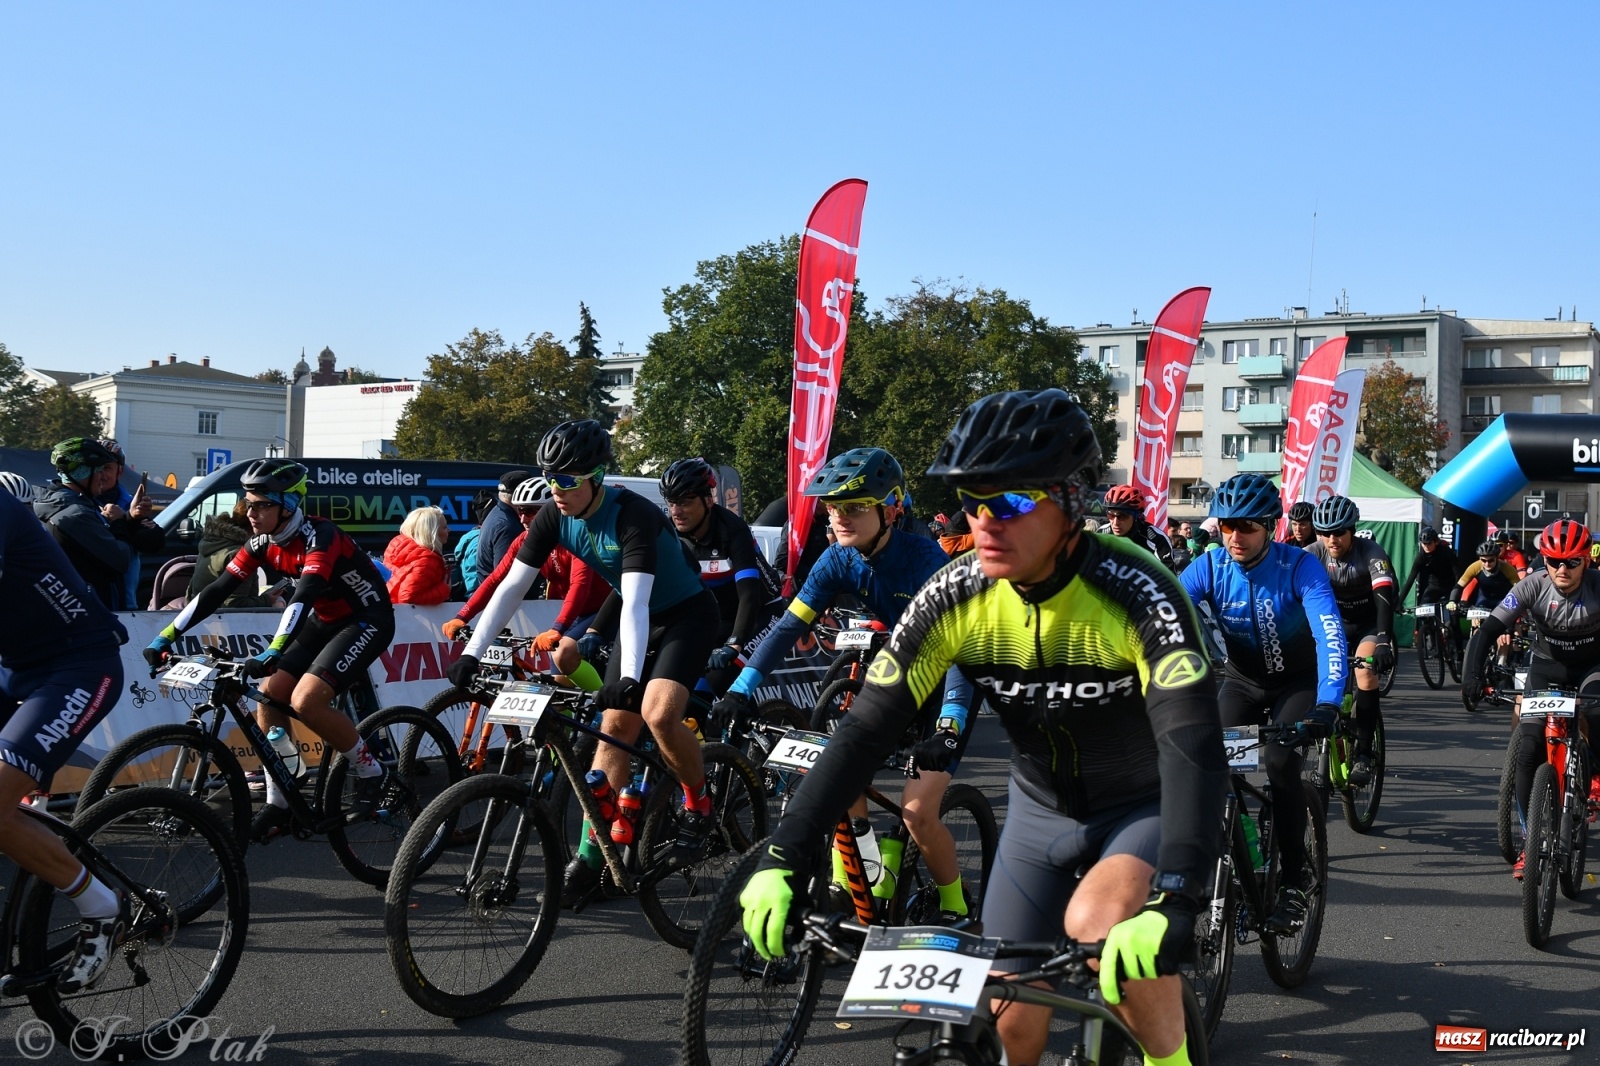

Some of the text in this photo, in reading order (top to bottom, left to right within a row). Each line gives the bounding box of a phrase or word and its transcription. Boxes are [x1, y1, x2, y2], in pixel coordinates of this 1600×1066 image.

[361, 384, 414, 394] BLACK RED WHITE
[317, 467, 421, 486] bike atelier
[41, 573, 86, 619] FENIX
[341, 569, 380, 607] BMC
[1100, 559, 1185, 643] AUTHOR
[336, 624, 378, 673] GARMIN
[842, 633, 867, 641] 2406
[1319, 613, 1344, 686] WEILANDT
[1575, 637, 1594, 645] BYTOM
[171, 665, 202, 679] 2196
[976, 676, 1133, 699] AUTHOR
[73, 677, 111, 735] CAFFEINE SHAMPOO
[500, 697, 537, 712] 2011
[1529, 700, 1565, 709] 2667
[34, 687, 92, 753] Alpecin
[874, 964, 963, 993] 1384
